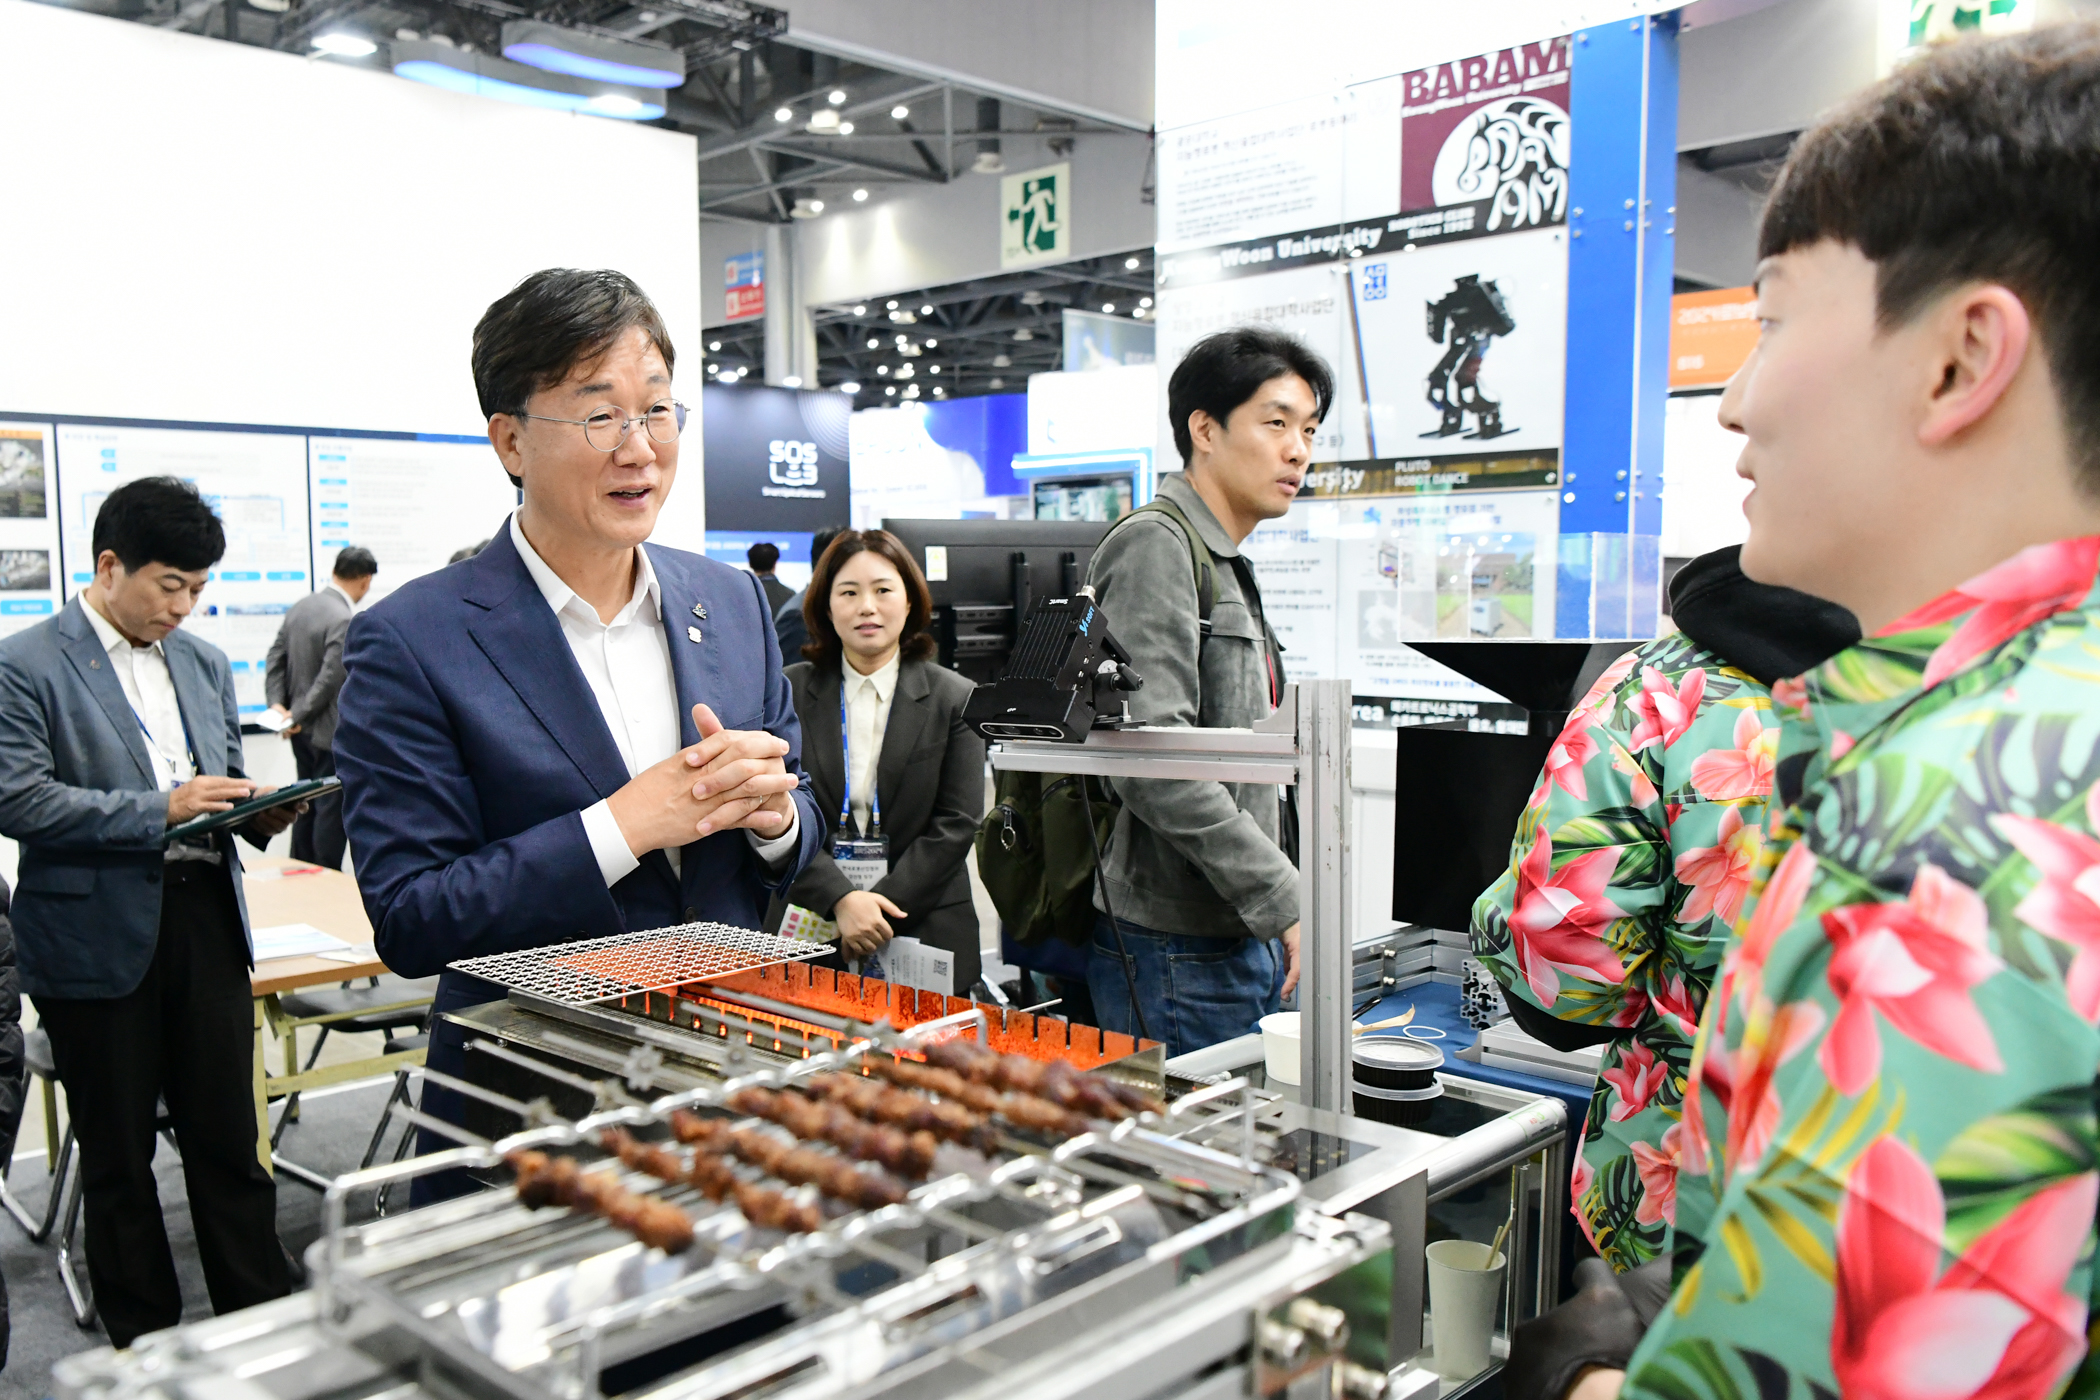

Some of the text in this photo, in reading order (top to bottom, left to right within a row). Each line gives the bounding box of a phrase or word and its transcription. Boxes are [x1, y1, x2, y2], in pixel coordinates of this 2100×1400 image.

[1402, 37, 1571, 103] BARAM
[1277, 226, 1384, 260] University
[768, 440, 819, 464] SOS
[1395, 460, 1431, 474] PLUTO
[1351, 704, 1385, 722] rea
